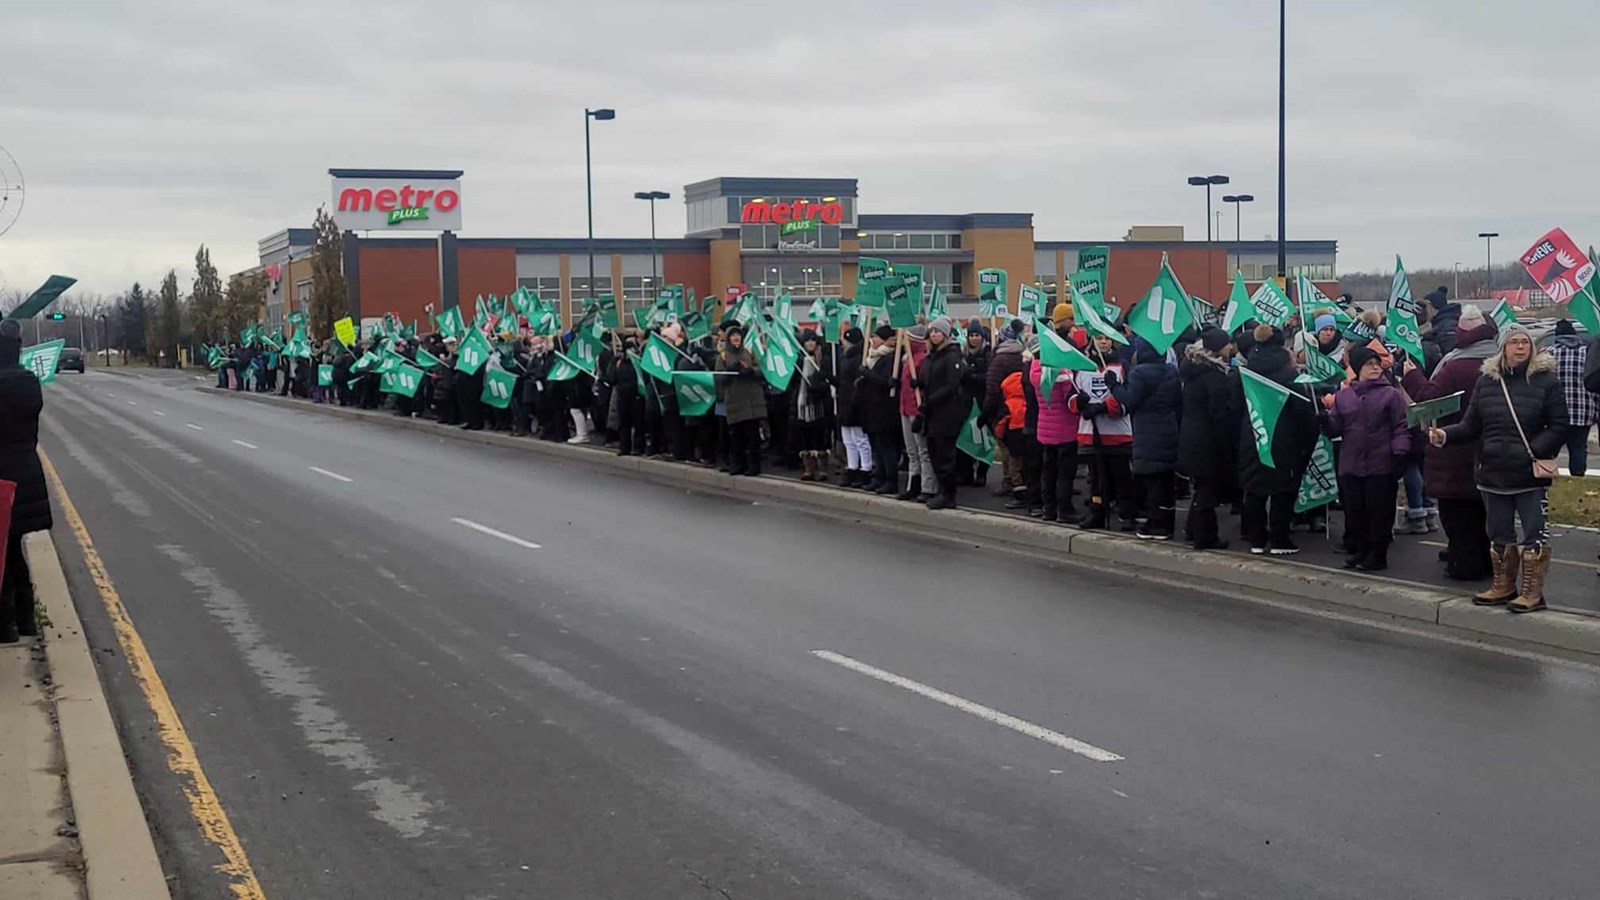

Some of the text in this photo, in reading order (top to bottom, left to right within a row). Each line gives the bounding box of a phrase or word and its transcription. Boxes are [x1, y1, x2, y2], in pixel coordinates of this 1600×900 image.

[338, 185, 459, 212] metro
[392, 208, 420, 221] PLUS
[742, 198, 842, 224] metro
[786, 221, 810, 231] PLUS
